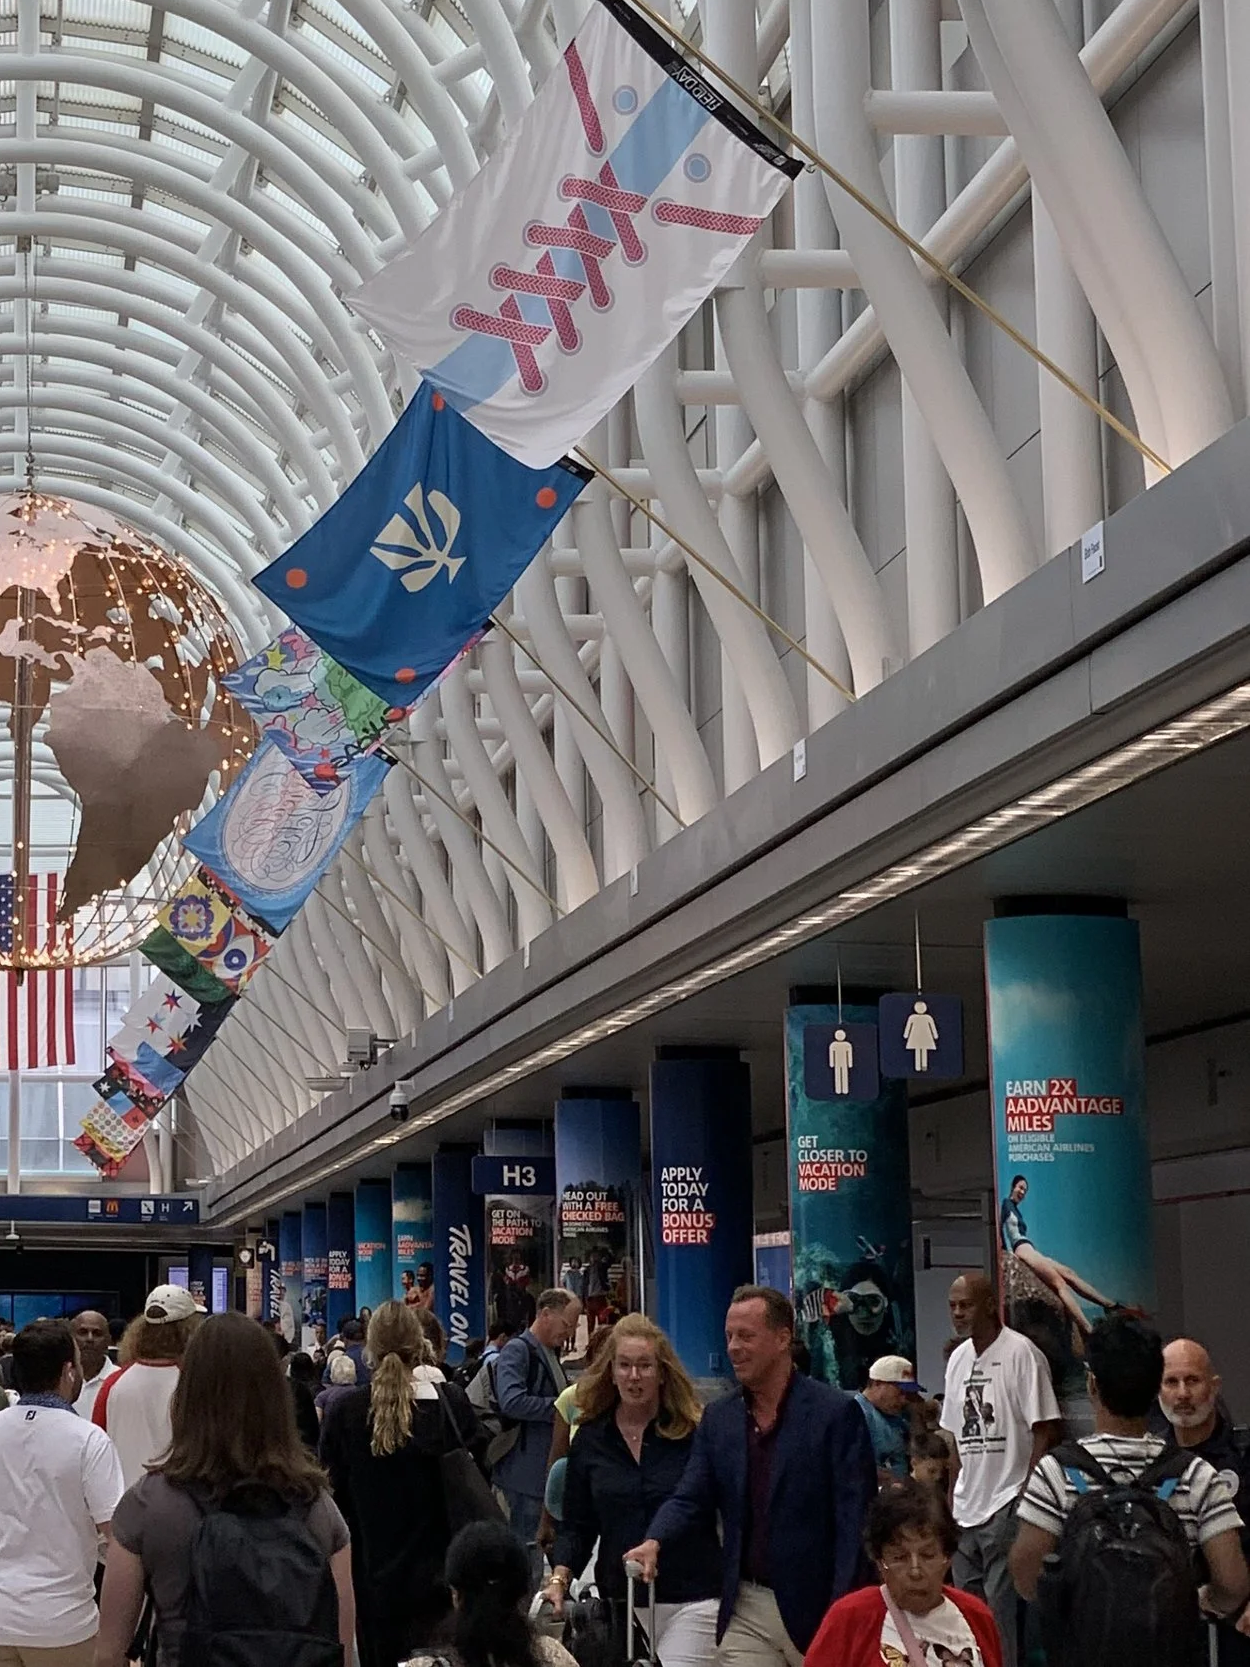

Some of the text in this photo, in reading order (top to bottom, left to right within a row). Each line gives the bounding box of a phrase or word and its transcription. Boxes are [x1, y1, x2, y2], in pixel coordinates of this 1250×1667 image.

[671, 67, 698, 92] DAY
[1006, 1079, 1074, 1096] EARN 2X
[1006, 1097, 1121, 1114] AADVANTAGE
[1007, 1116, 1052, 1132] MILES
[798, 1135, 818, 1149] GET
[1007, 1134, 1055, 1143] ON ELIGIBLE
[1008, 1143, 1095, 1153] AMERICAN AIRLINES
[798, 1149, 868, 1162] CLOSER TO
[1008, 1152, 1055, 1162] PURCHASES
[503, 1165, 536, 1187] H3
[661, 1167, 702, 1182] APPLY
[798, 1163, 865, 1177] VACATION
[661, 1183, 709, 1197] TODAY
[799, 1177, 836, 1191] MODE
[562, 1191, 608, 1201] HEAD OUT
[161, 1203, 170, 1213] H
[562, 1202, 619, 1211] WITH A FREE
[662, 1198, 705, 1212] FOR A
[491, 1210, 521, 1218] GET ON
[562, 1212, 625, 1222] CHECKED BAG
[662, 1213, 714, 1228] BONUS
[491, 1218, 542, 1228] THE PATH TO
[491, 1227, 533, 1236] VACATION
[663, 1229, 708, 1243] OFFER
[491, 1236, 516, 1245] MODE
[448, 1224, 473, 1348] TRAVEL ON
